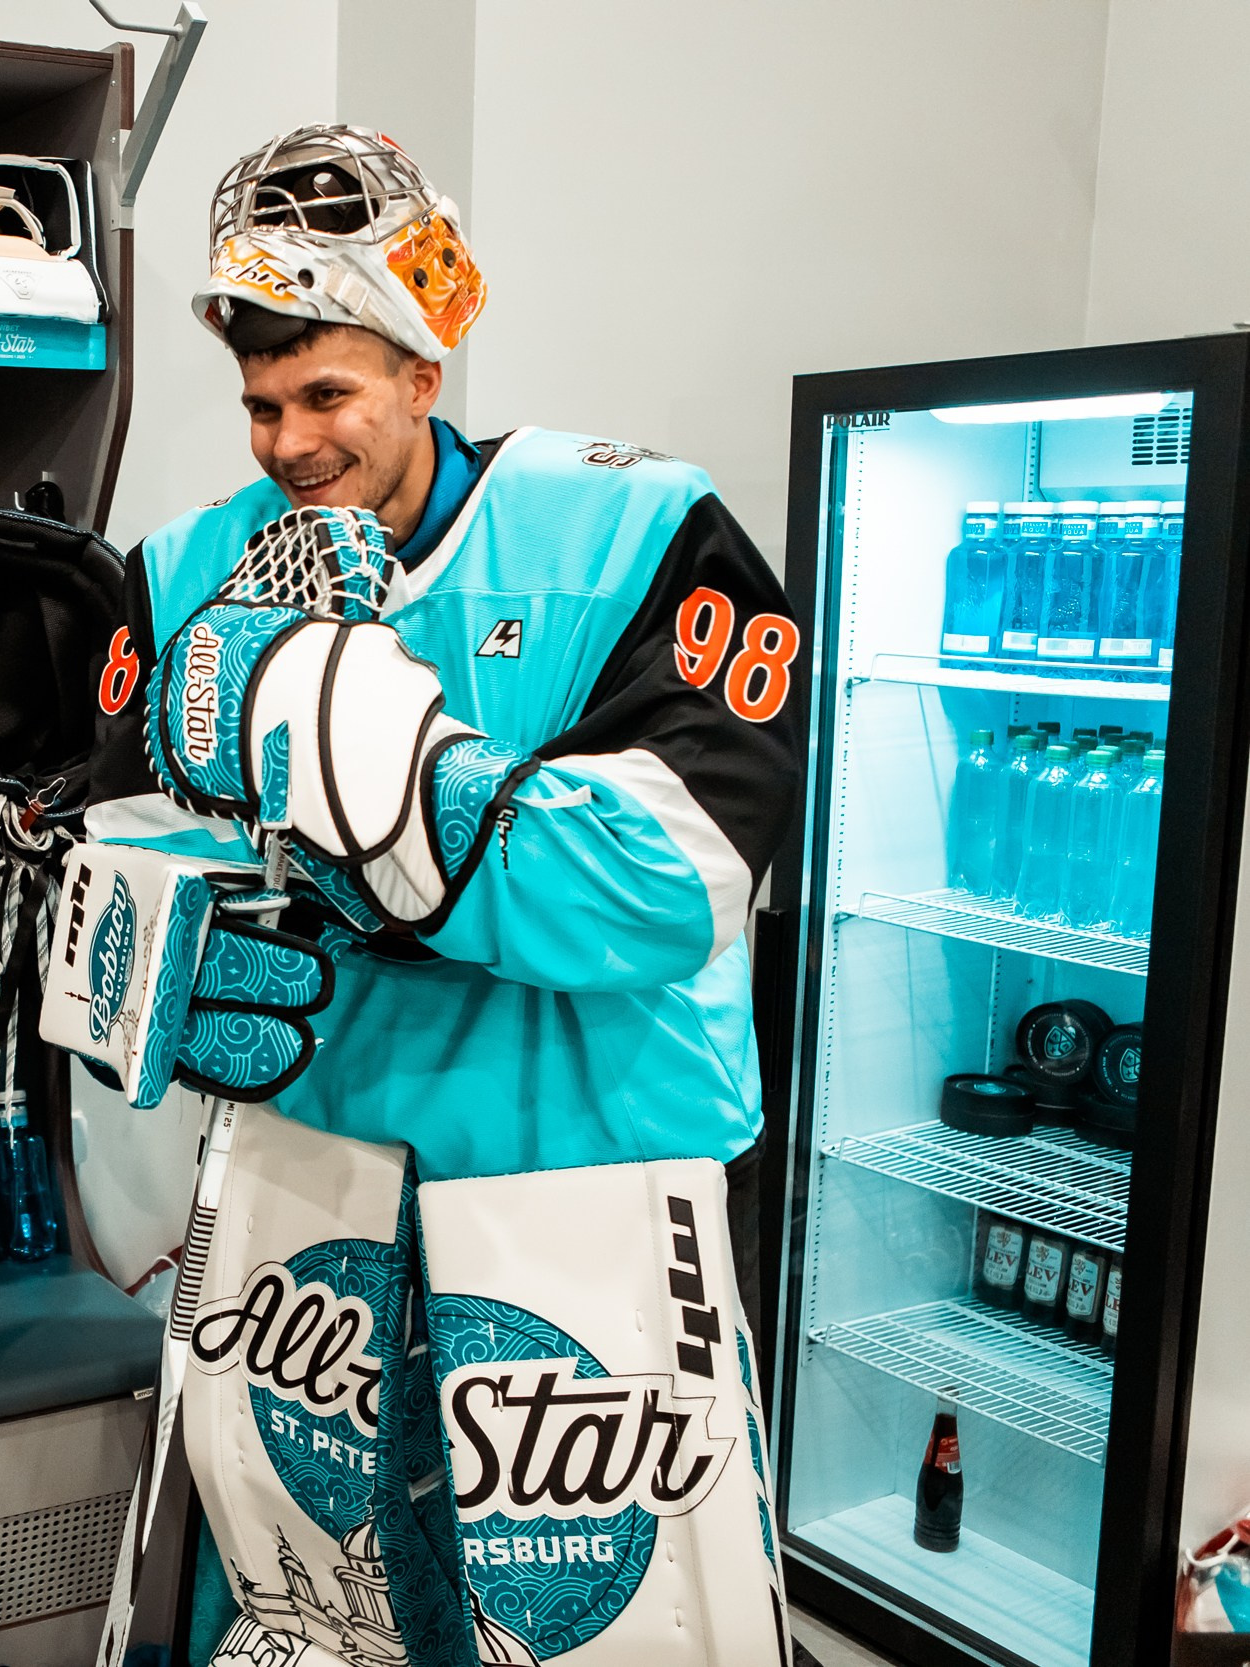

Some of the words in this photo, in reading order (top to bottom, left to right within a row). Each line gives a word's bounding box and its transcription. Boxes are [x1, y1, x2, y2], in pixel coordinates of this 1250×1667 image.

[826, 411, 891, 430] POLAIR
[673, 586, 800, 723] 98
[185, 625, 220, 762] All-Star
[90, 881, 128, 1041] Bobrov
[116, 923, 132, 1002] DIVISION
[987, 1248, 1019, 1267] LEV
[1026, 1264, 1059, 1282] LEV
[271, 1409, 305, 1445] ST.
[313, 1428, 377, 1475] PETE
[463, 1534, 614, 1567] RSBURG
